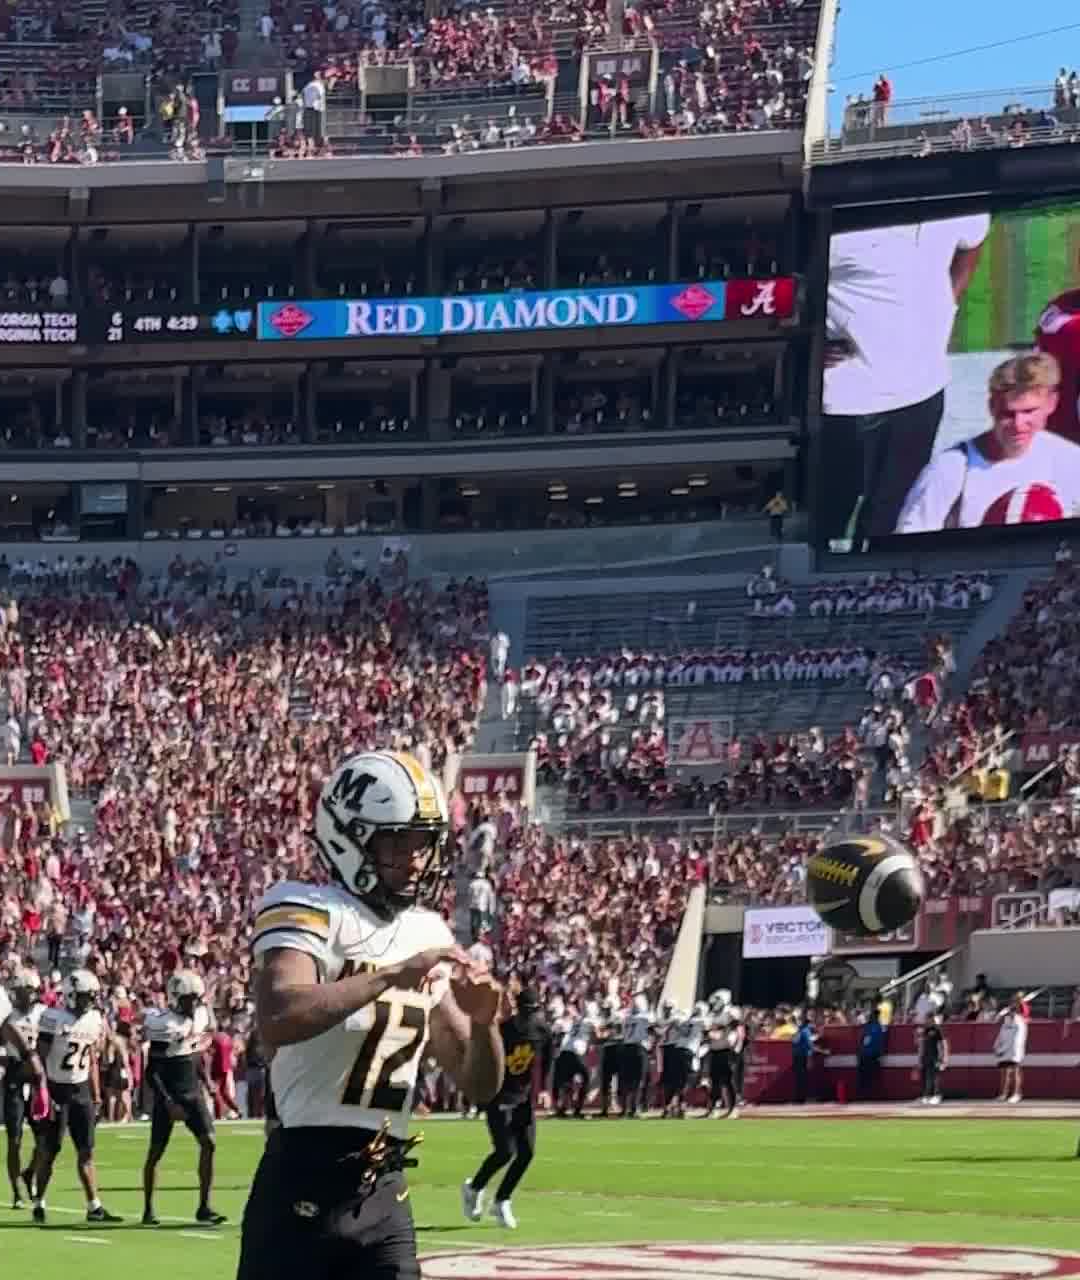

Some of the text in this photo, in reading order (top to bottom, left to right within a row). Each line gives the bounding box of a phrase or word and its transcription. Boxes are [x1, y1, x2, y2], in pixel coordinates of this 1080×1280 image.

[43, 312, 78, 328] TECH
[345, 301, 425, 336] RED
[439, 292, 639, 335] DIAMOND
[134, 317, 162, 332] 4TH
[43, 327, 78, 342] TECH
[340, 999, 426, 1110] 12
